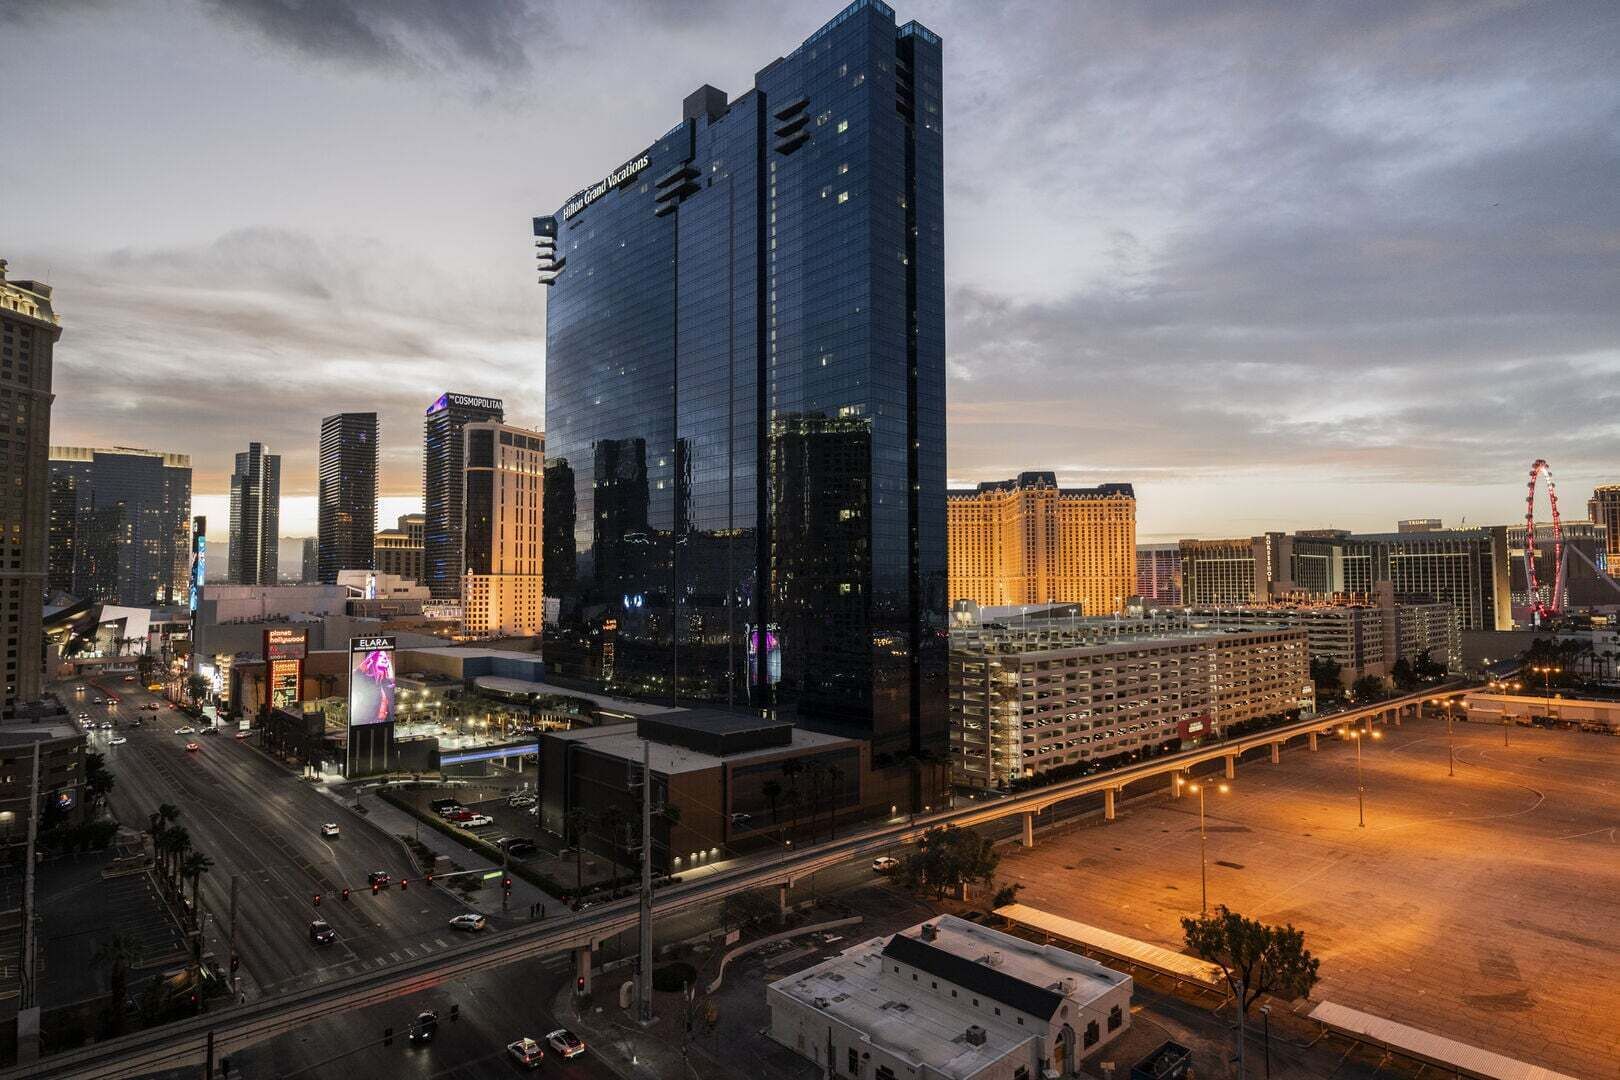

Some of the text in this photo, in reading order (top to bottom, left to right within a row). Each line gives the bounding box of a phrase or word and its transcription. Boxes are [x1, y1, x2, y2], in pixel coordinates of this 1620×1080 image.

[563, 155, 648, 220] Hilton Grand Vacations
[454, 396, 503, 409] COSMOPOLITAN
[270, 635, 305, 644] hollywood
[359, 638, 388, 647] ELARA
